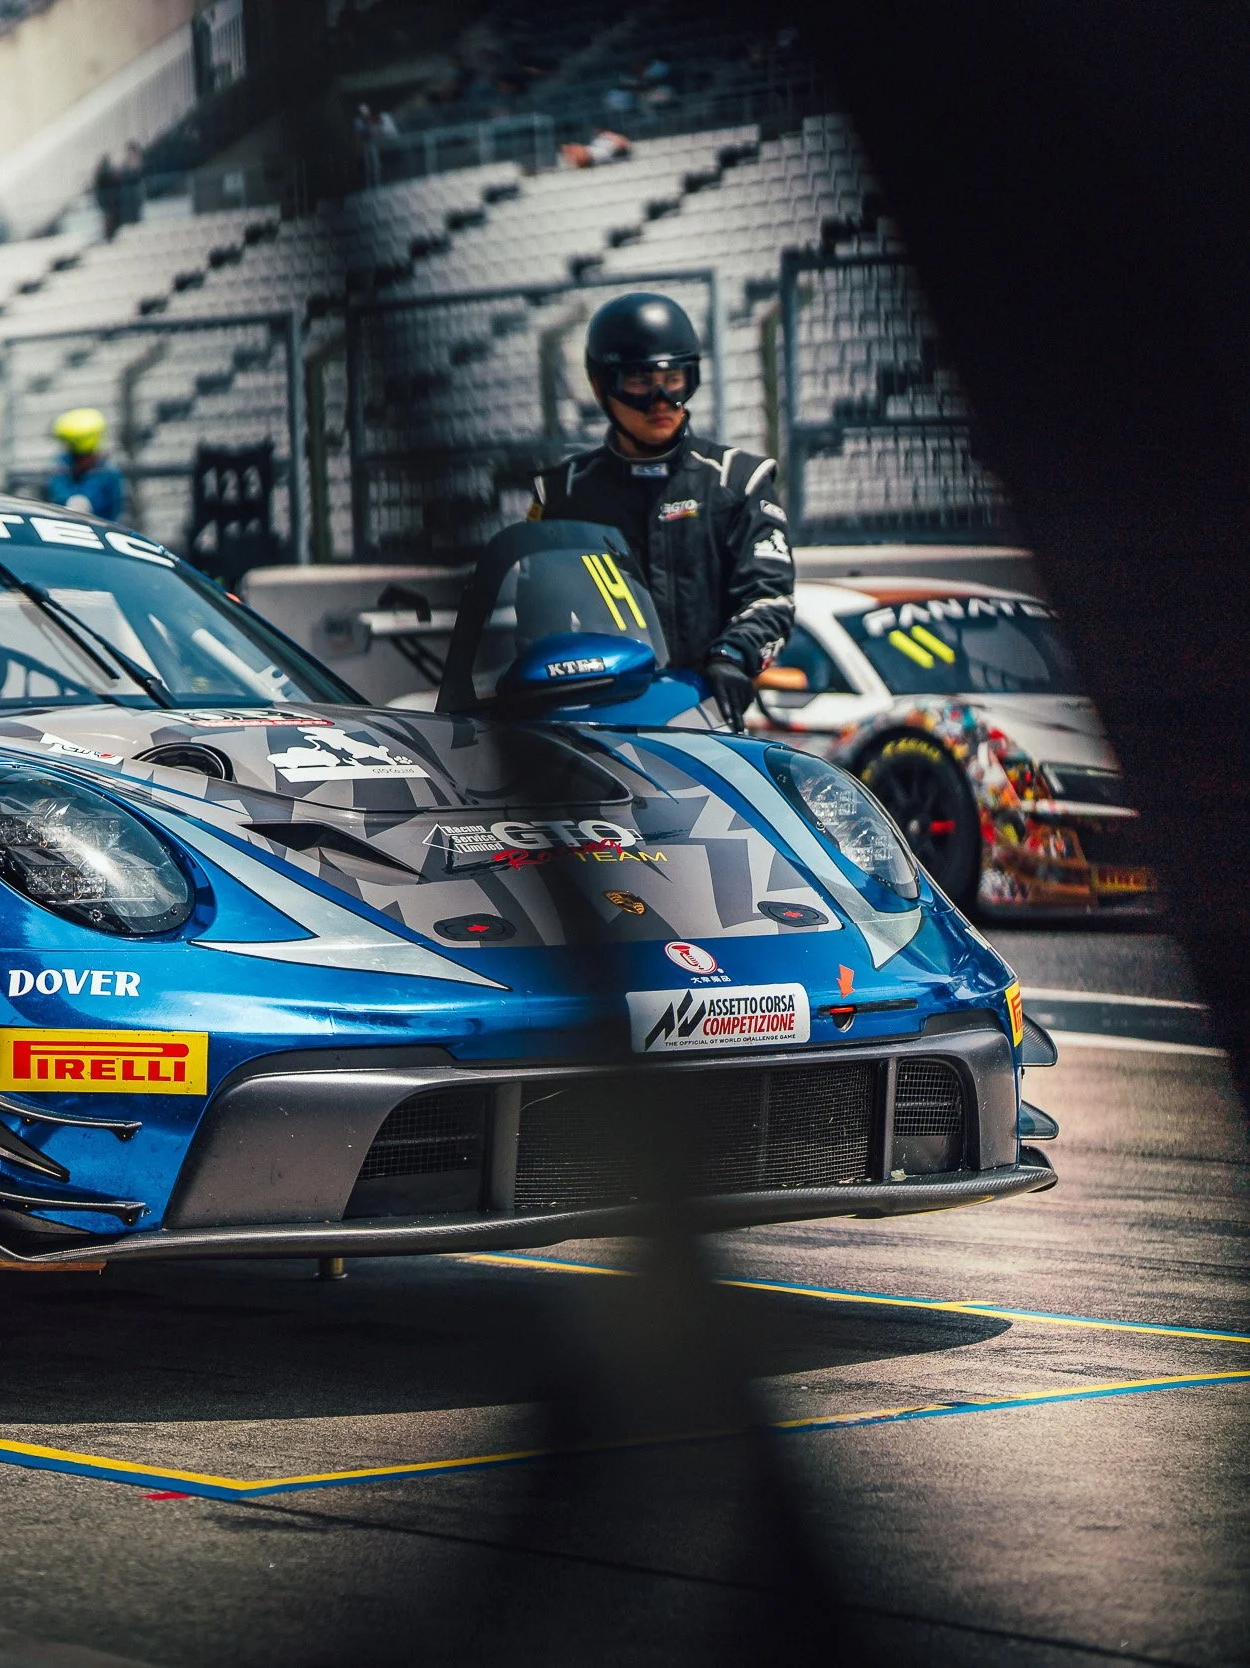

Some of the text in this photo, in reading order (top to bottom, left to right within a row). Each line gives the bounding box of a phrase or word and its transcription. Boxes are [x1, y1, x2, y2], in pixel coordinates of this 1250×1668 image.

[581, 553, 647, 631] 14
[862, 598, 1061, 637] FANATE
[443, 824, 486, 835] Racing
[454, 834, 495, 844] Service
[490, 820, 636, 849] GTO
[455, 842, 504, 853] Limited
[576, 851, 668, 862] TEAM
[8, 969, 141, 997] DOVER
[707, 994, 795, 1017] ASSETTO CORSA
[702, 1013, 795, 1036] COMPETIZIONE
[13, 1040, 189, 1082] PIRELLI
